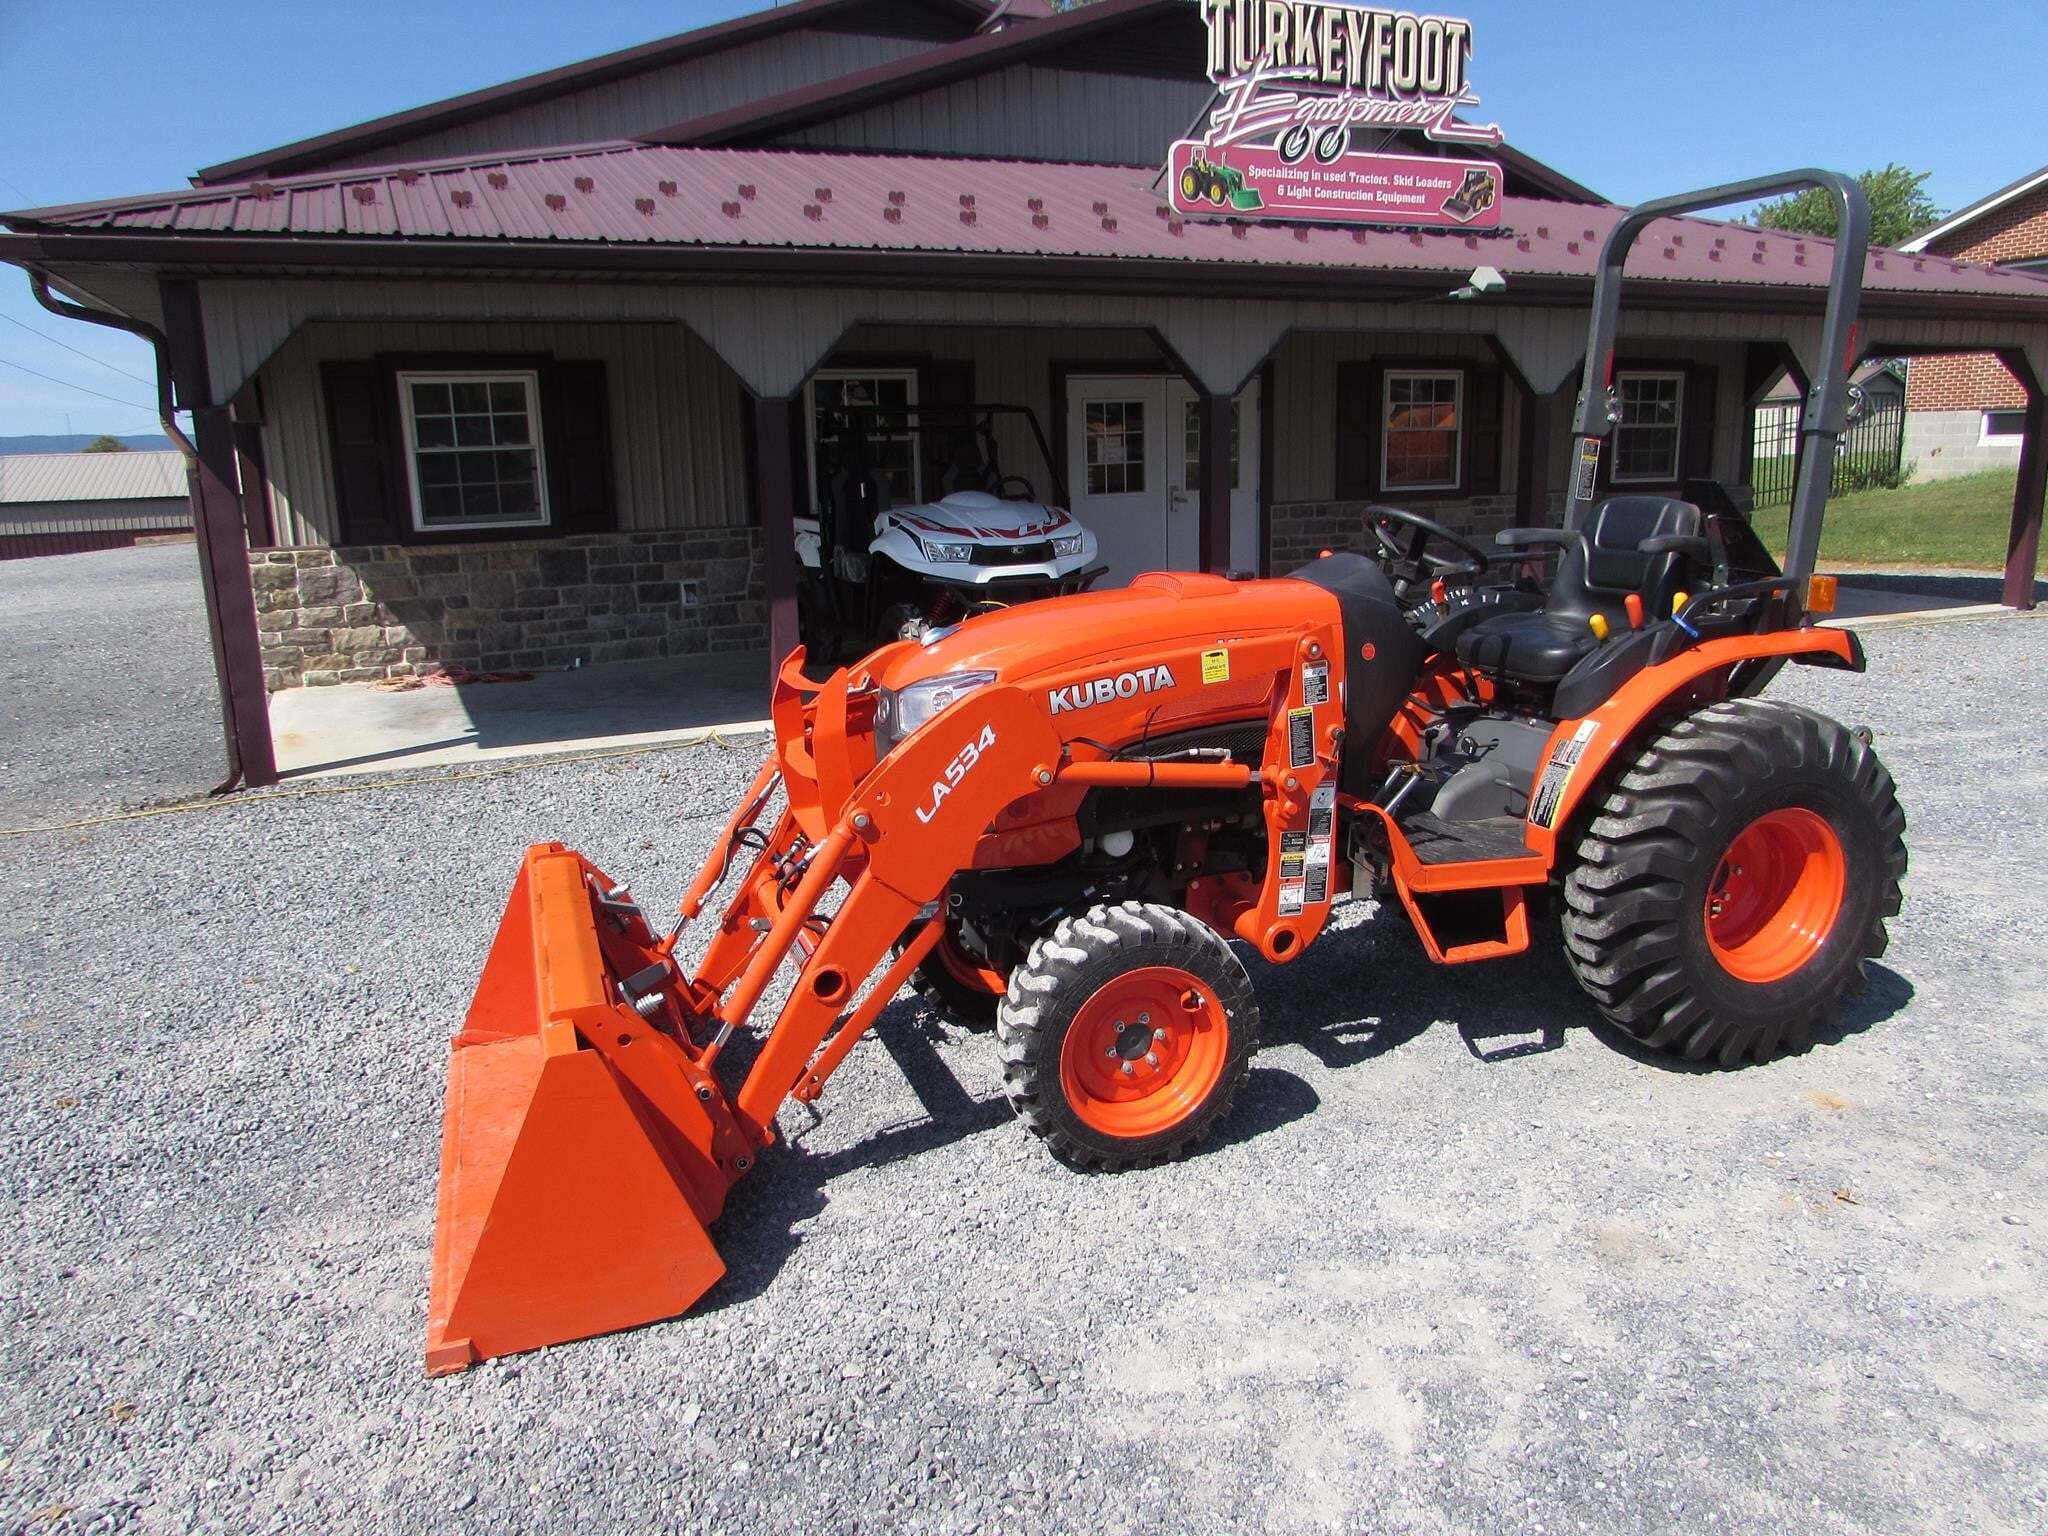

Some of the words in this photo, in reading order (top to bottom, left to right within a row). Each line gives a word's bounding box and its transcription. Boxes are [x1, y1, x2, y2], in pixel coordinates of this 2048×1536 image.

[1205, 0, 1469, 97] TURKEYFOOT
[1206, 54, 1502, 150] Equipment
[1248, 164, 1309, 183] Specializing
[1311, 169, 1321, 181] in
[1323, 171, 1346, 184] used
[1393, 174, 1414, 187] Skid
[1415, 175, 1452, 190] Loaders
[1287, 184, 1312, 200] Light
[1314, 187, 1374, 201] Construction
[1376, 190, 1426, 206] Equipment
[1048, 664, 1176, 715] KUBOTA
[915, 723, 997, 824] LA534
